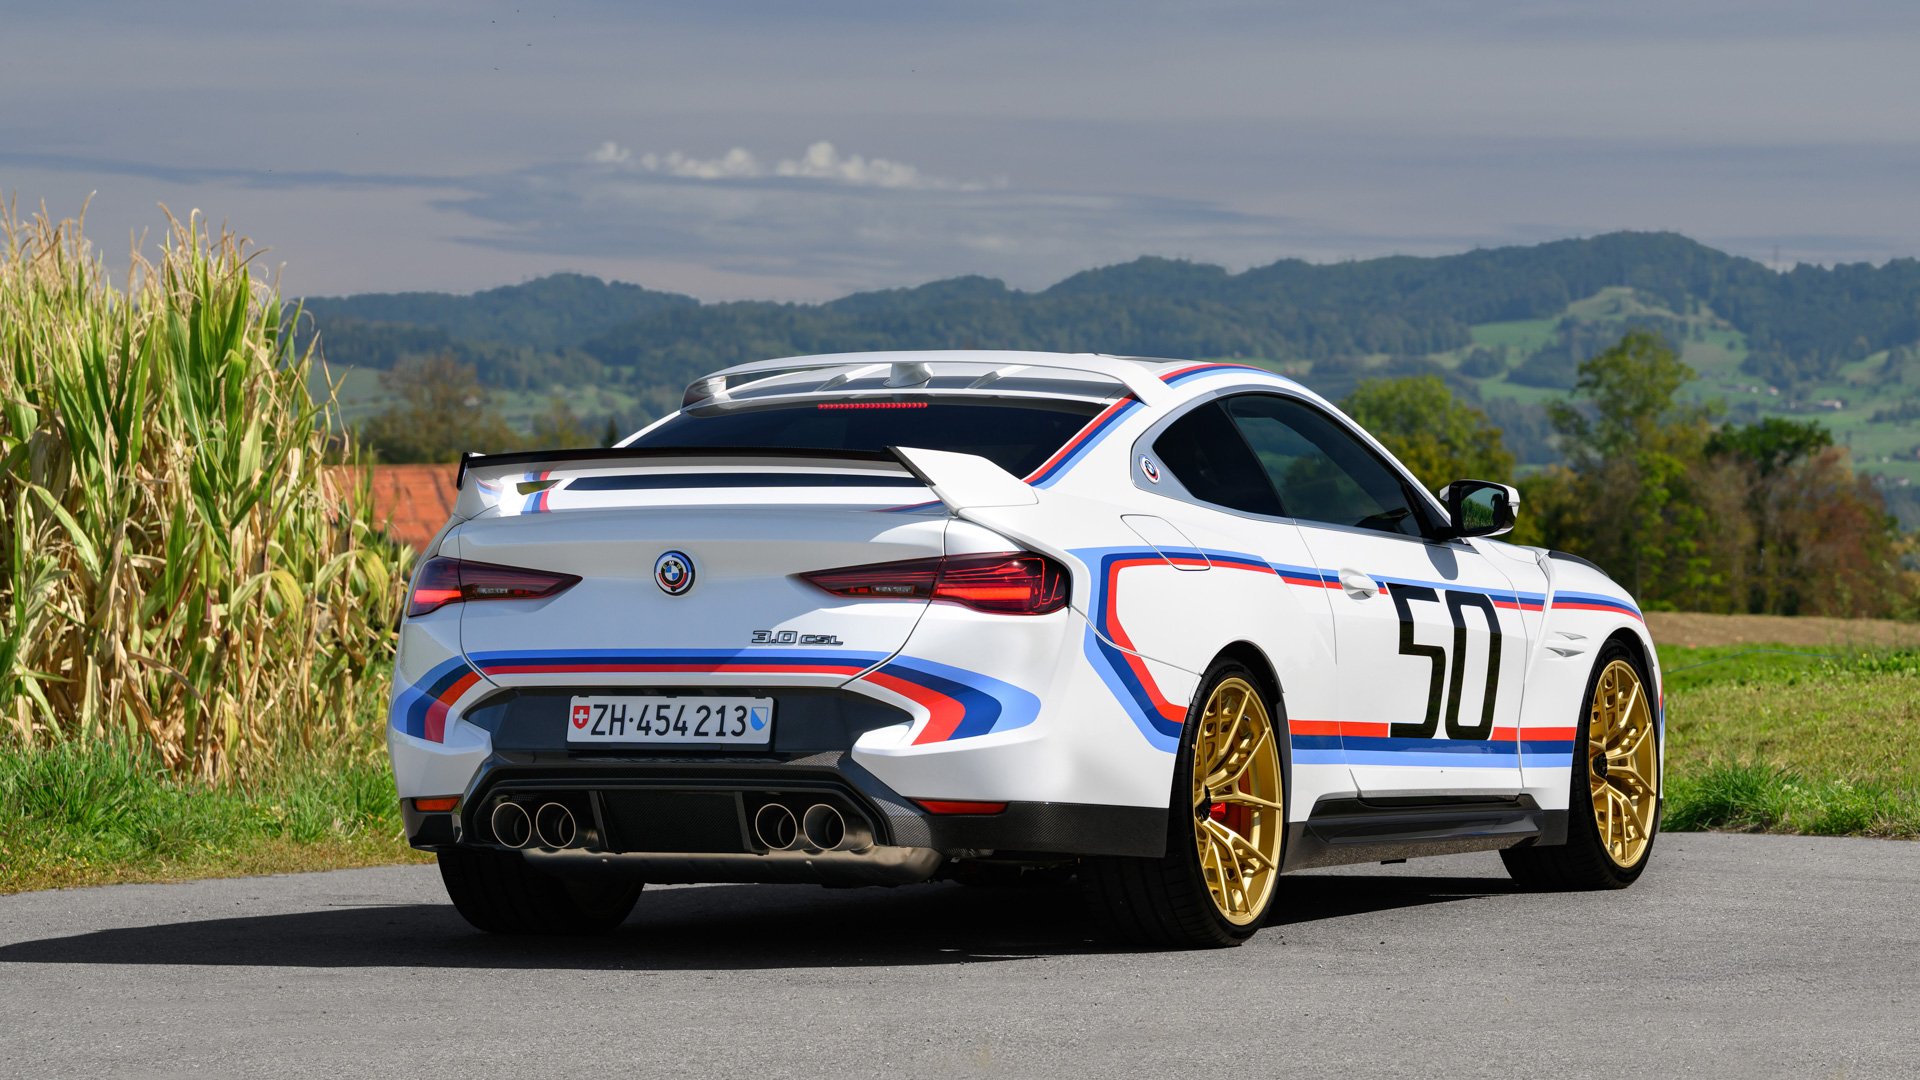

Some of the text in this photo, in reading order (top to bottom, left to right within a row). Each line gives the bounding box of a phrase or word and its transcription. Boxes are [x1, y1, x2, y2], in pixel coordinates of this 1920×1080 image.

[751, 630, 844, 646] 3.0 CSL
[1386, 582, 1502, 741] 50
